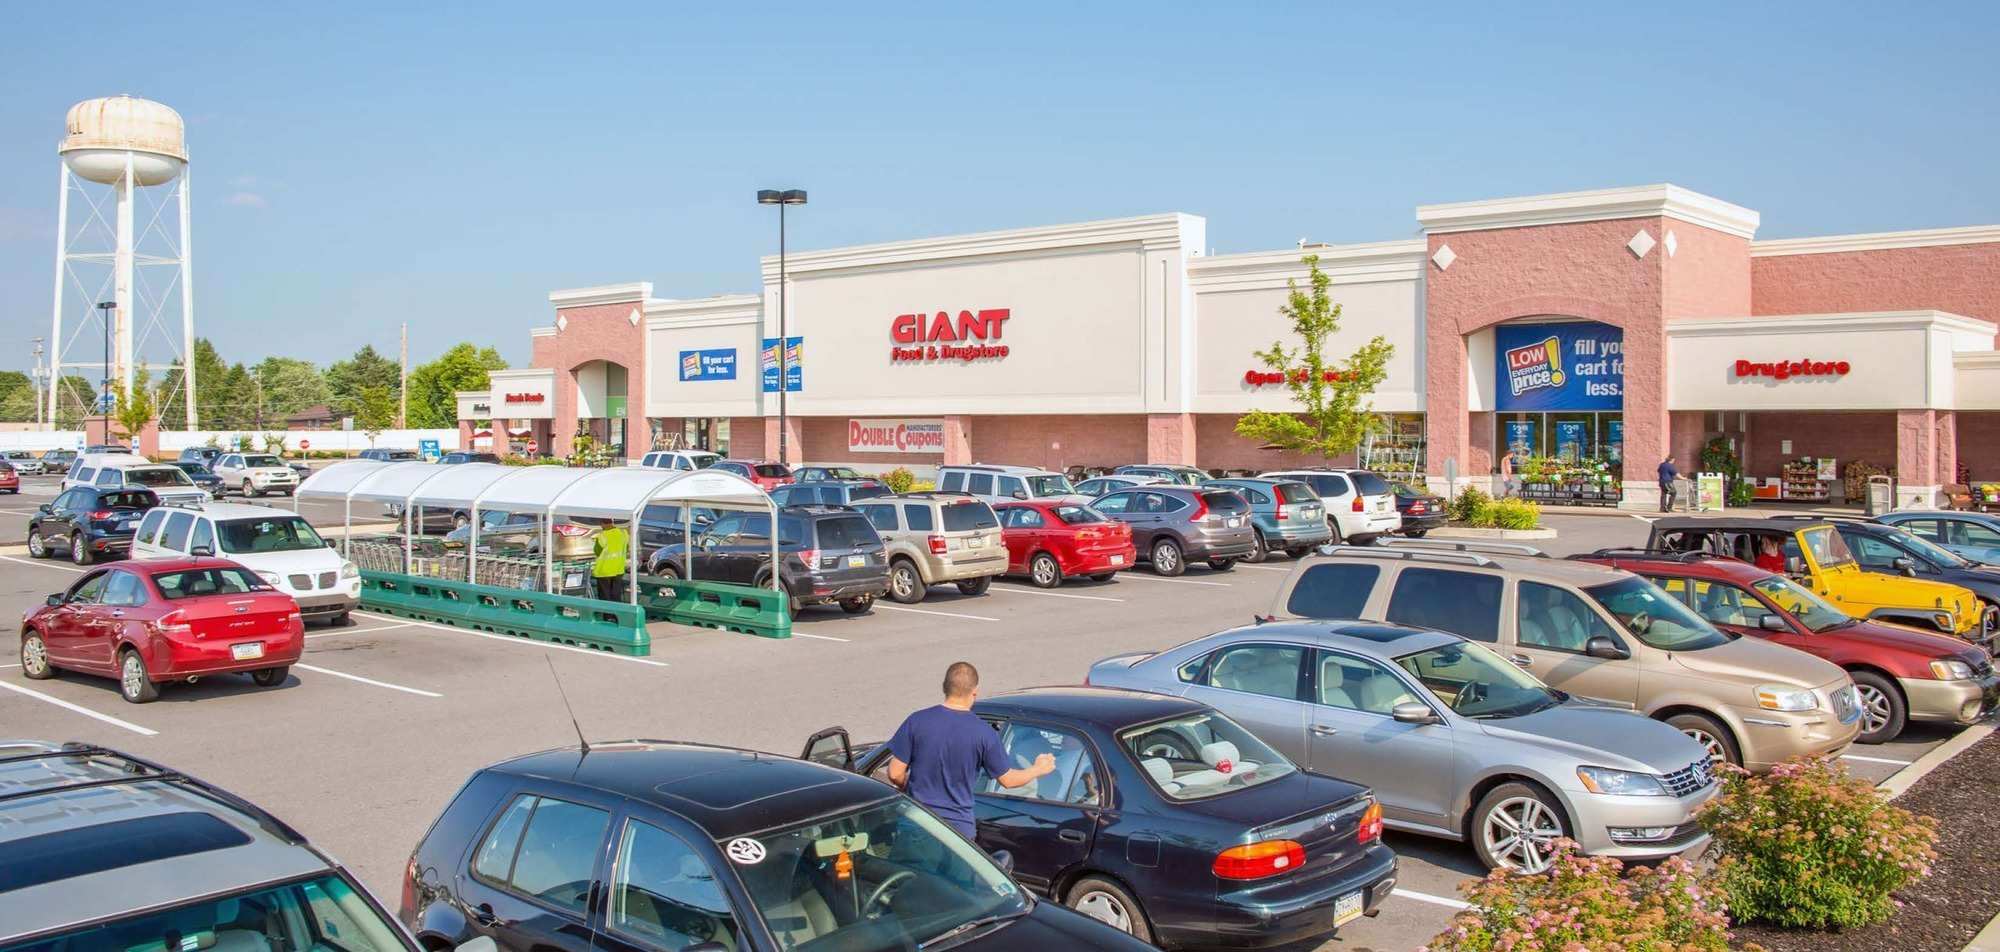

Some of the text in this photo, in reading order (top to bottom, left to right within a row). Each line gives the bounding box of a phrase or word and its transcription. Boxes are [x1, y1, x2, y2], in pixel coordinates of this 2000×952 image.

[892, 309, 1010, 343] GIANT
[893, 344, 1009, 362] Food & Drugstore
[1574, 339, 1596, 355] fill
[1510, 347, 1545, 368] LOW
[1511, 363, 1549, 378] EVERYDAY
[1575, 359, 1608, 376] cart
[1736, 358, 1850, 380] Drugstore
[1245, 370, 1285, 387] Open
[1586, 380, 1623, 396] less.
